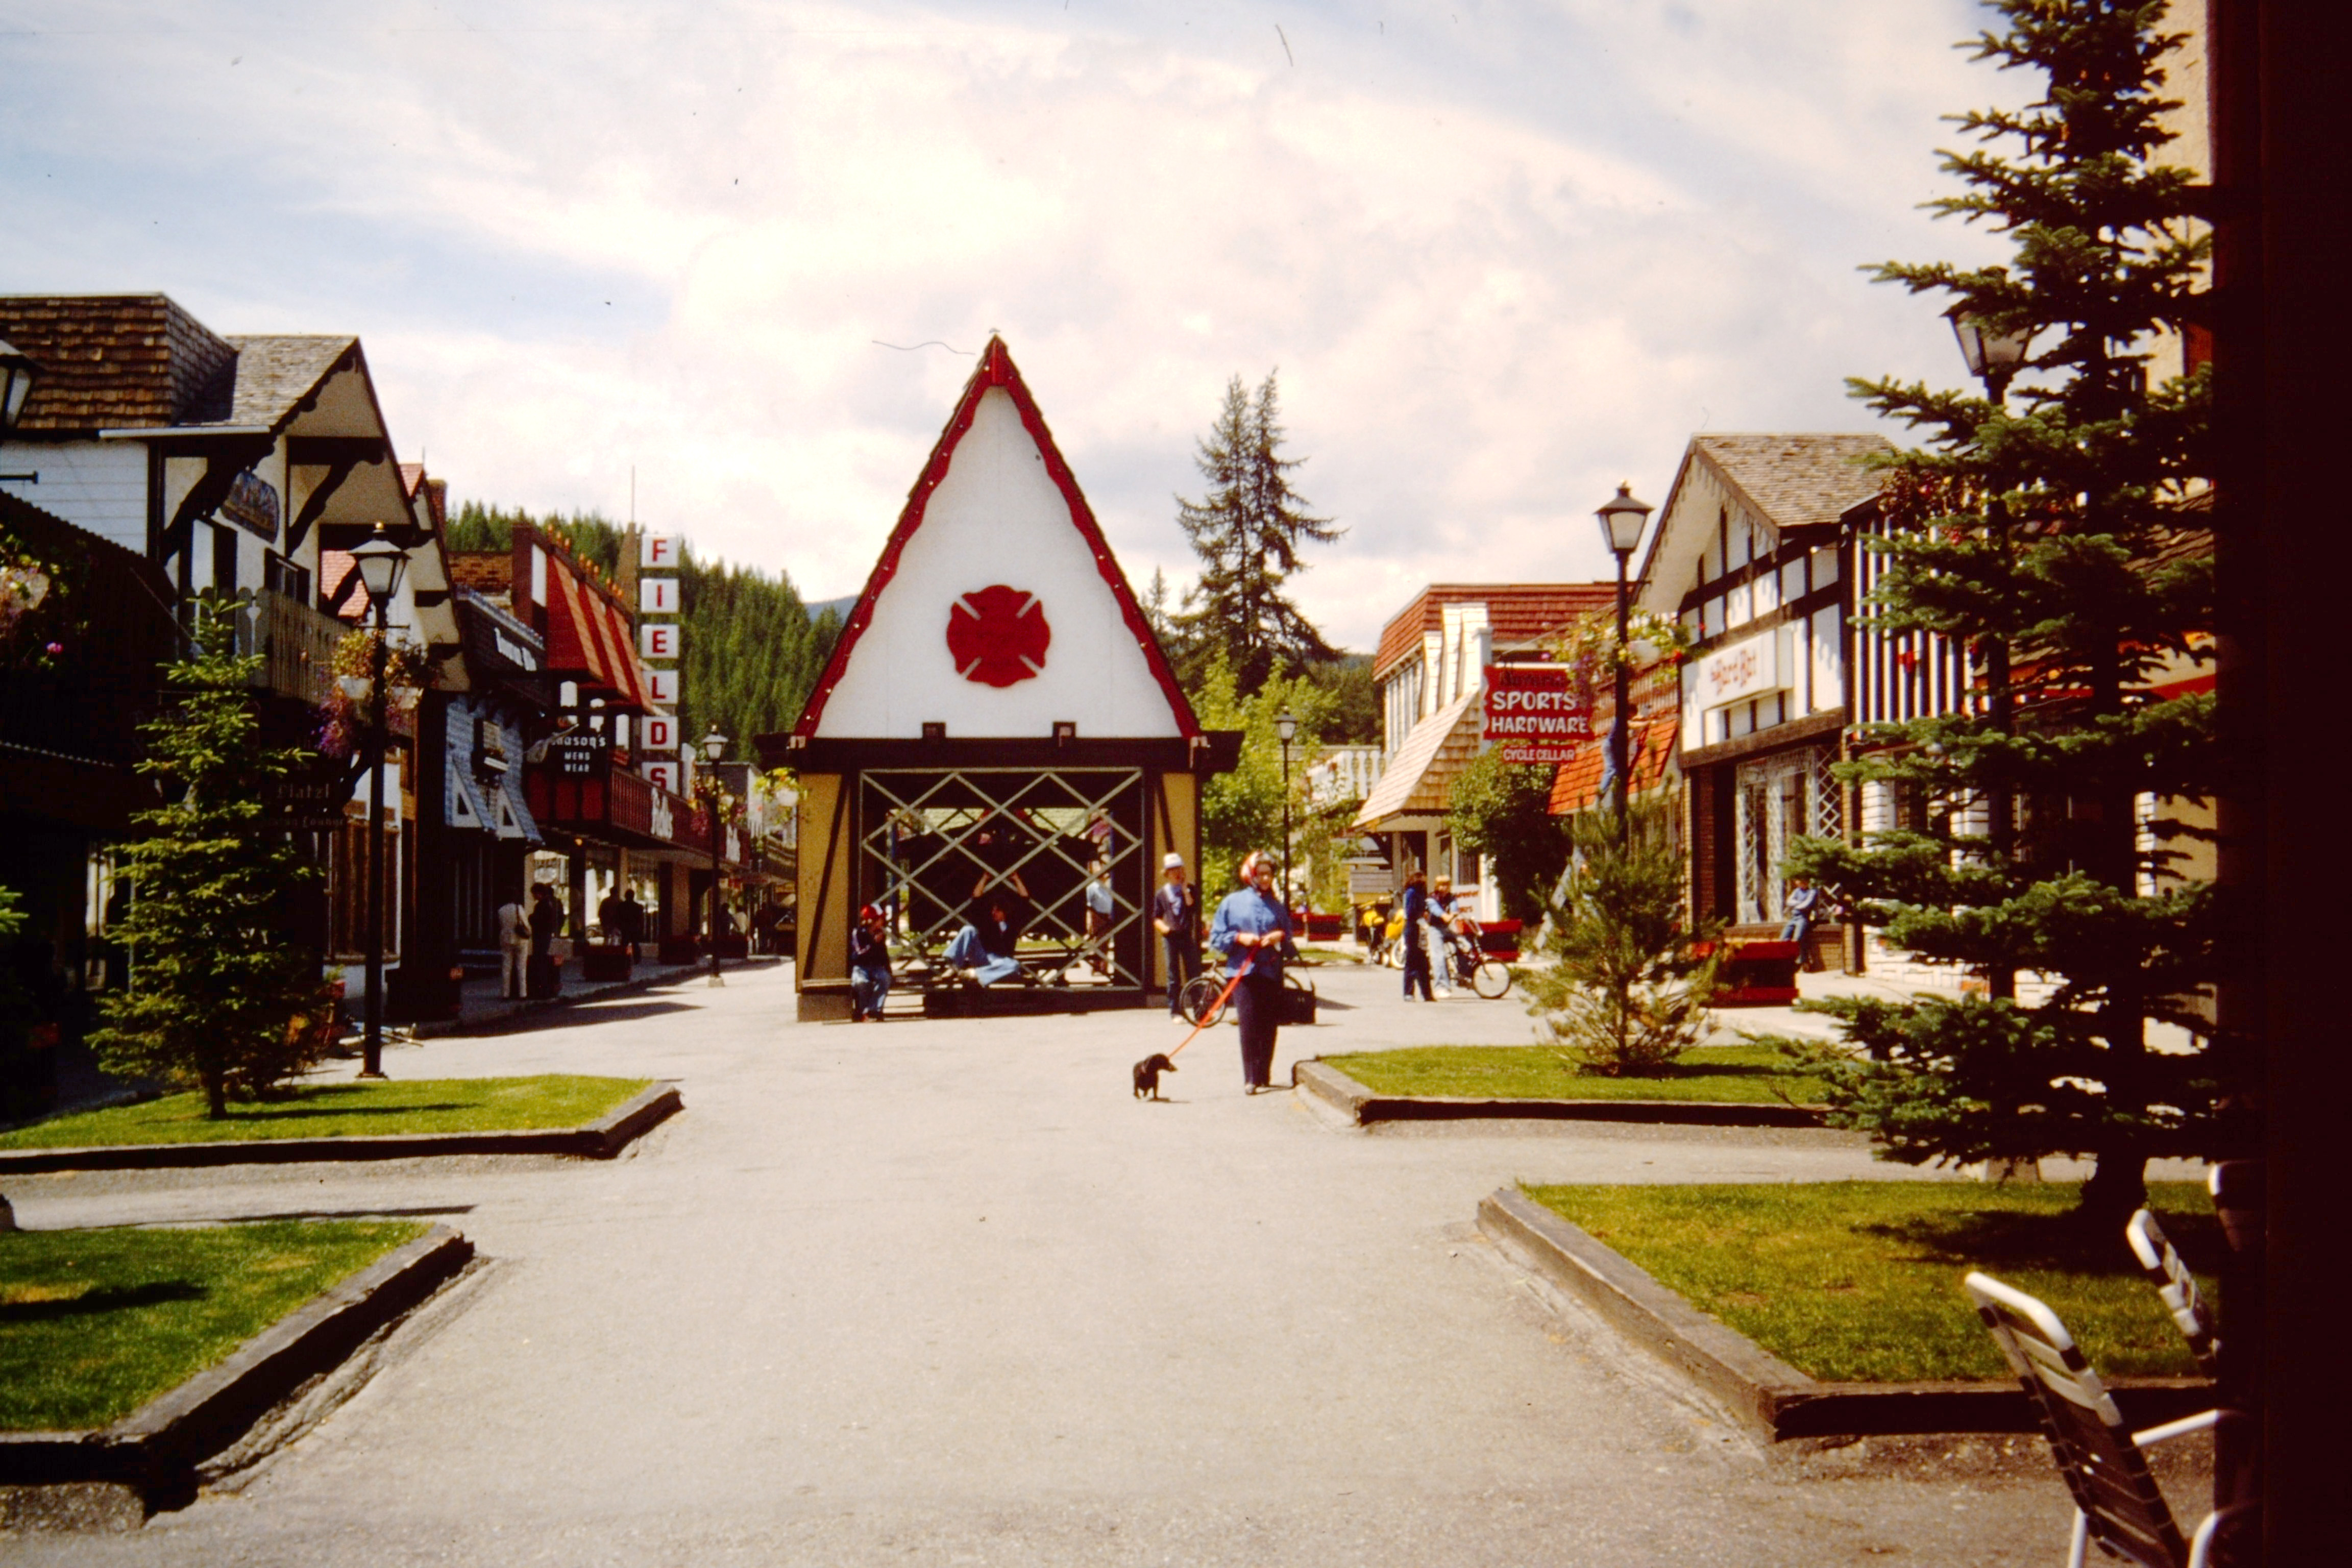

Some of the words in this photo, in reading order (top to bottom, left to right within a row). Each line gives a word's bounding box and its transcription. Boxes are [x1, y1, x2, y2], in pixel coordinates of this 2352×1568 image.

[651, 540, 668, 790] FIELDS
[1492, 691, 1577, 710] SPORTS
[1491, 716, 1589, 733] HARDWARE
[564, 751, 591, 761] MENS
[1503, 749, 1535, 761] CYCLE
[1536, 749, 1575, 761] CELLAR
[564, 763, 590, 772] WEAR
